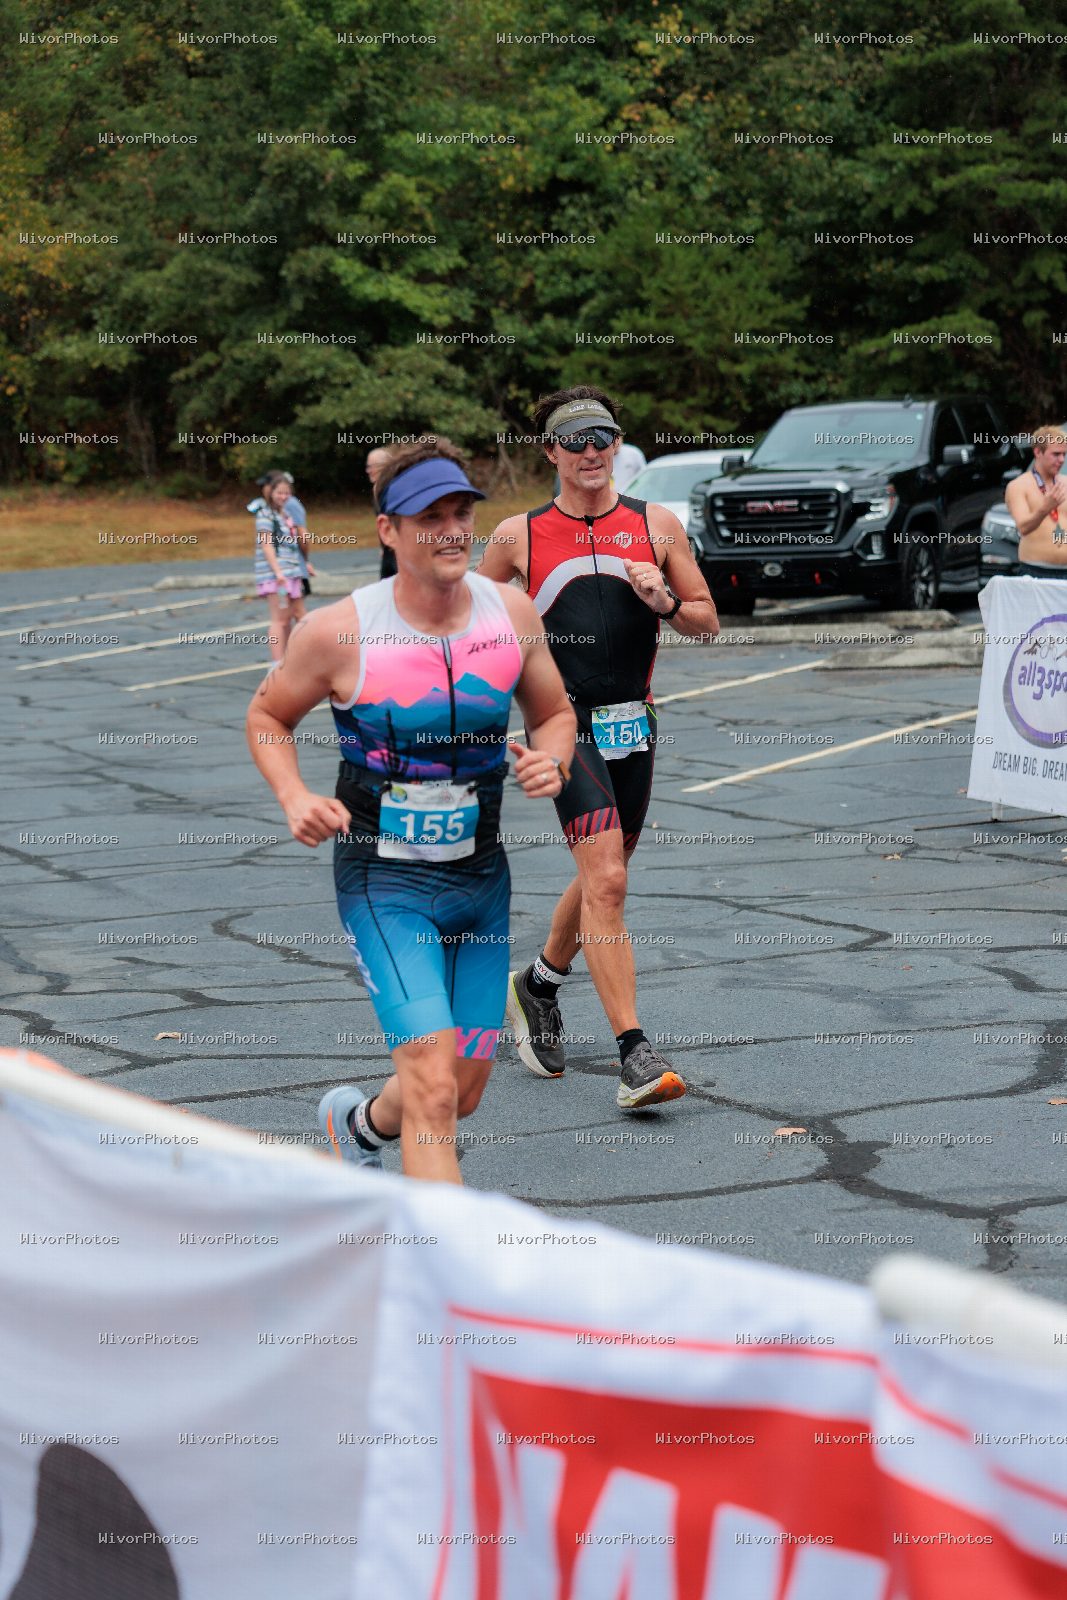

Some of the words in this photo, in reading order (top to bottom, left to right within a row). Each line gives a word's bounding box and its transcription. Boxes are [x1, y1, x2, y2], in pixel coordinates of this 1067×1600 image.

[746, 499, 799, 513] GMC
[992, 751, 1021, 773] DREAM
[1022, 756, 1039, 776] BIG.
[1042, 759, 1067, 782] DREA
[400, 812, 465, 842] 155
